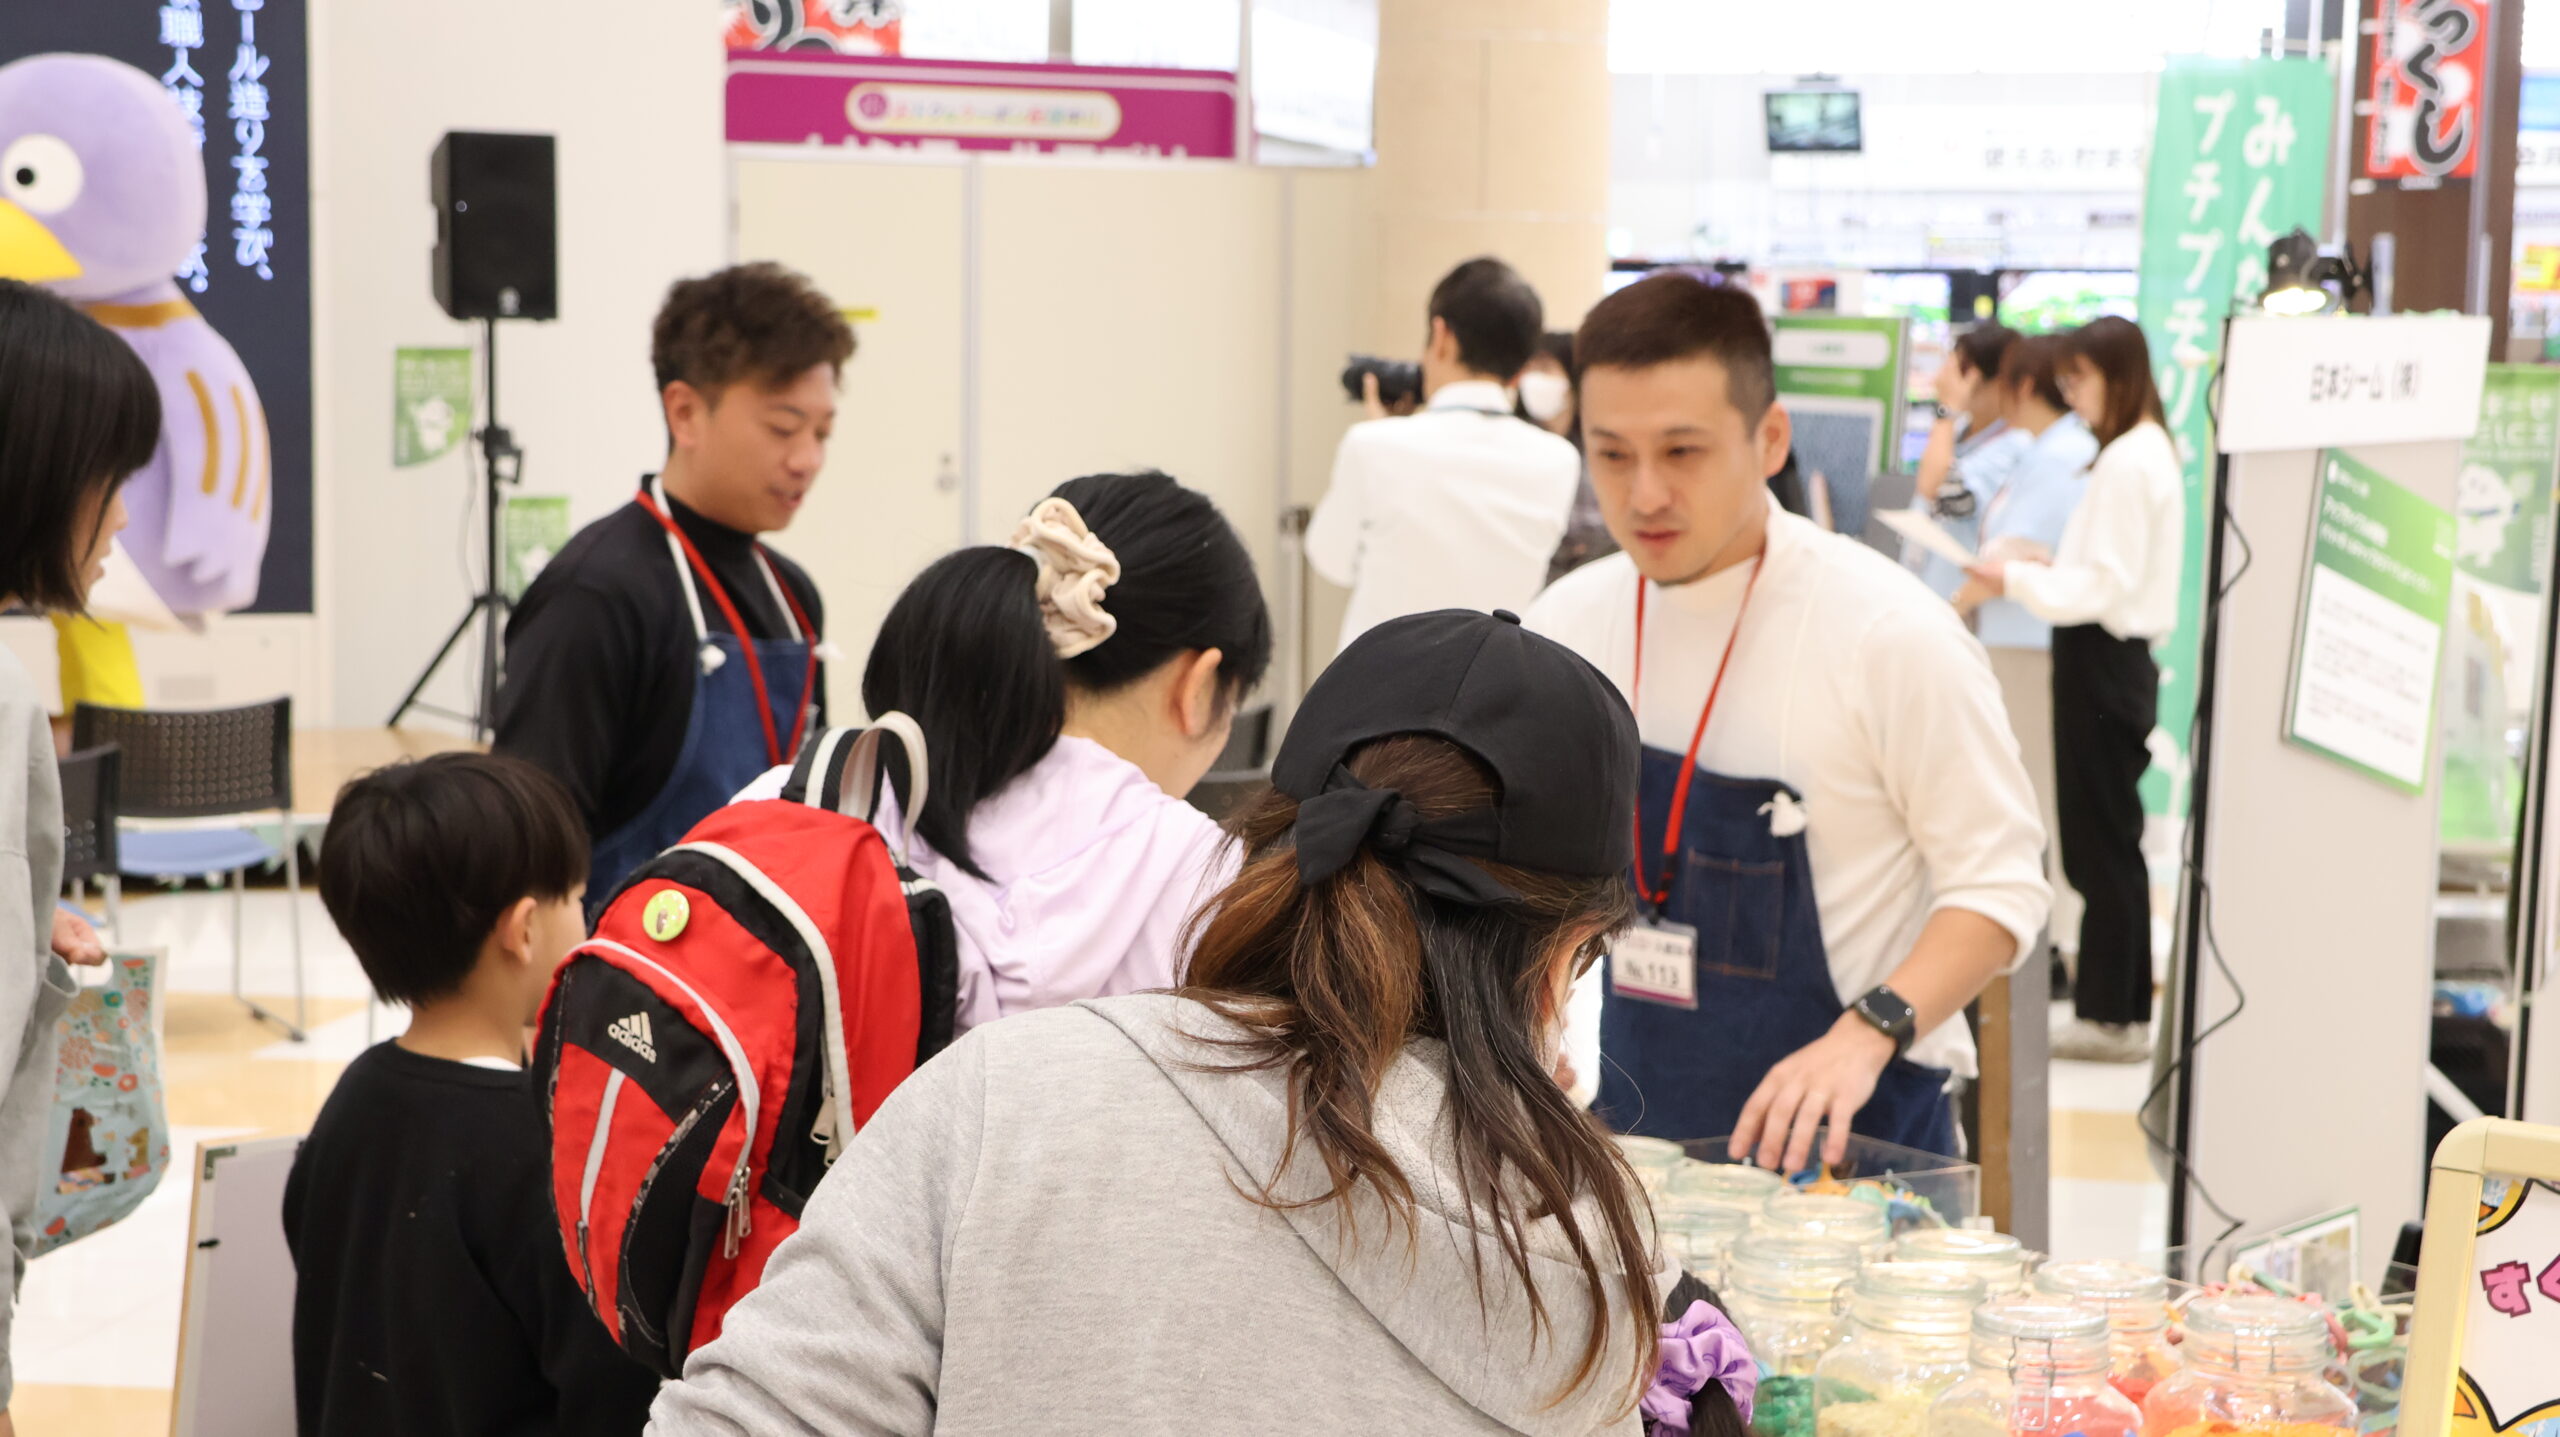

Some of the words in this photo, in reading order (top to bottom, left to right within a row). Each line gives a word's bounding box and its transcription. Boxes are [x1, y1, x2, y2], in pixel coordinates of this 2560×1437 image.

[227, 0, 274, 281] ール造りを学び、
[607, 1023, 657, 1064] adidas
